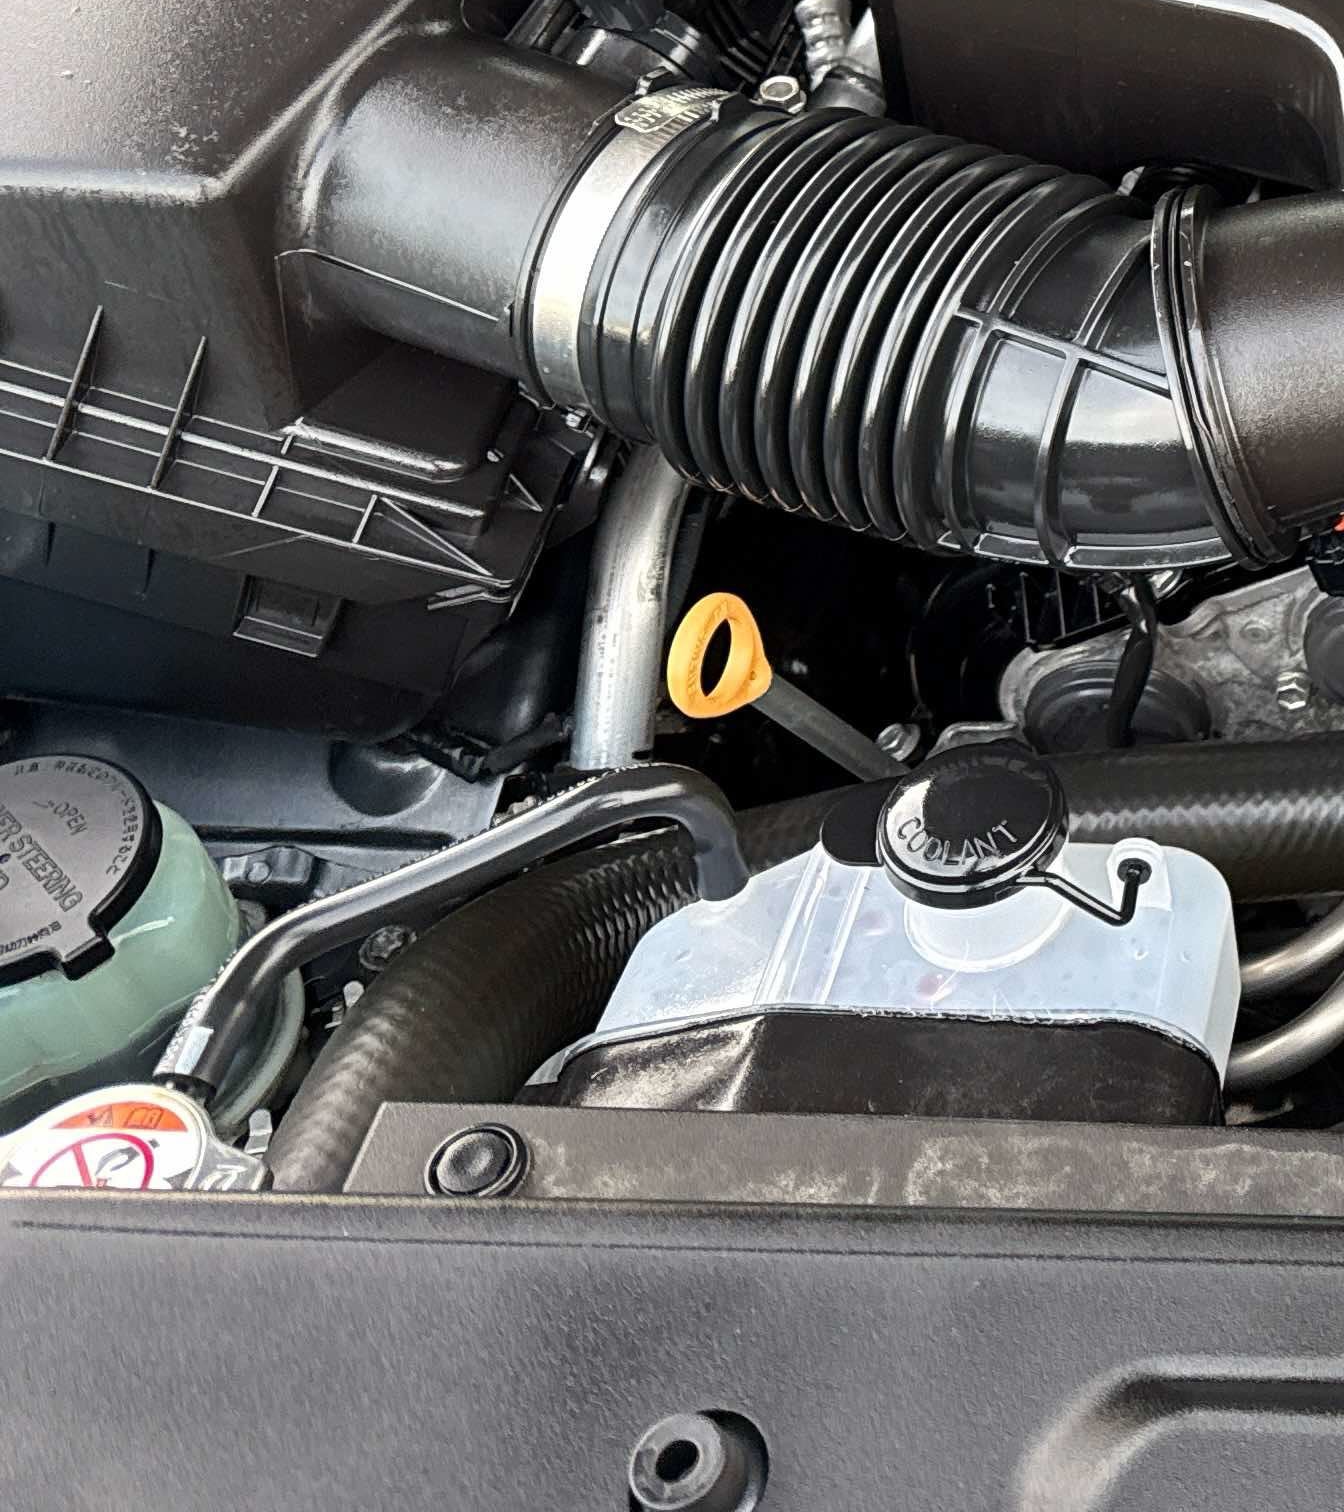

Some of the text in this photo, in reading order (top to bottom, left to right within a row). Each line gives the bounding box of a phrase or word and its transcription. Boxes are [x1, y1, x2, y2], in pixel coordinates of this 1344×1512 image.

[53, 801, 88, 836] OPEN
[896, 816, 1017, 866] COOLANT
[9, 833, 84, 913] STEERING
